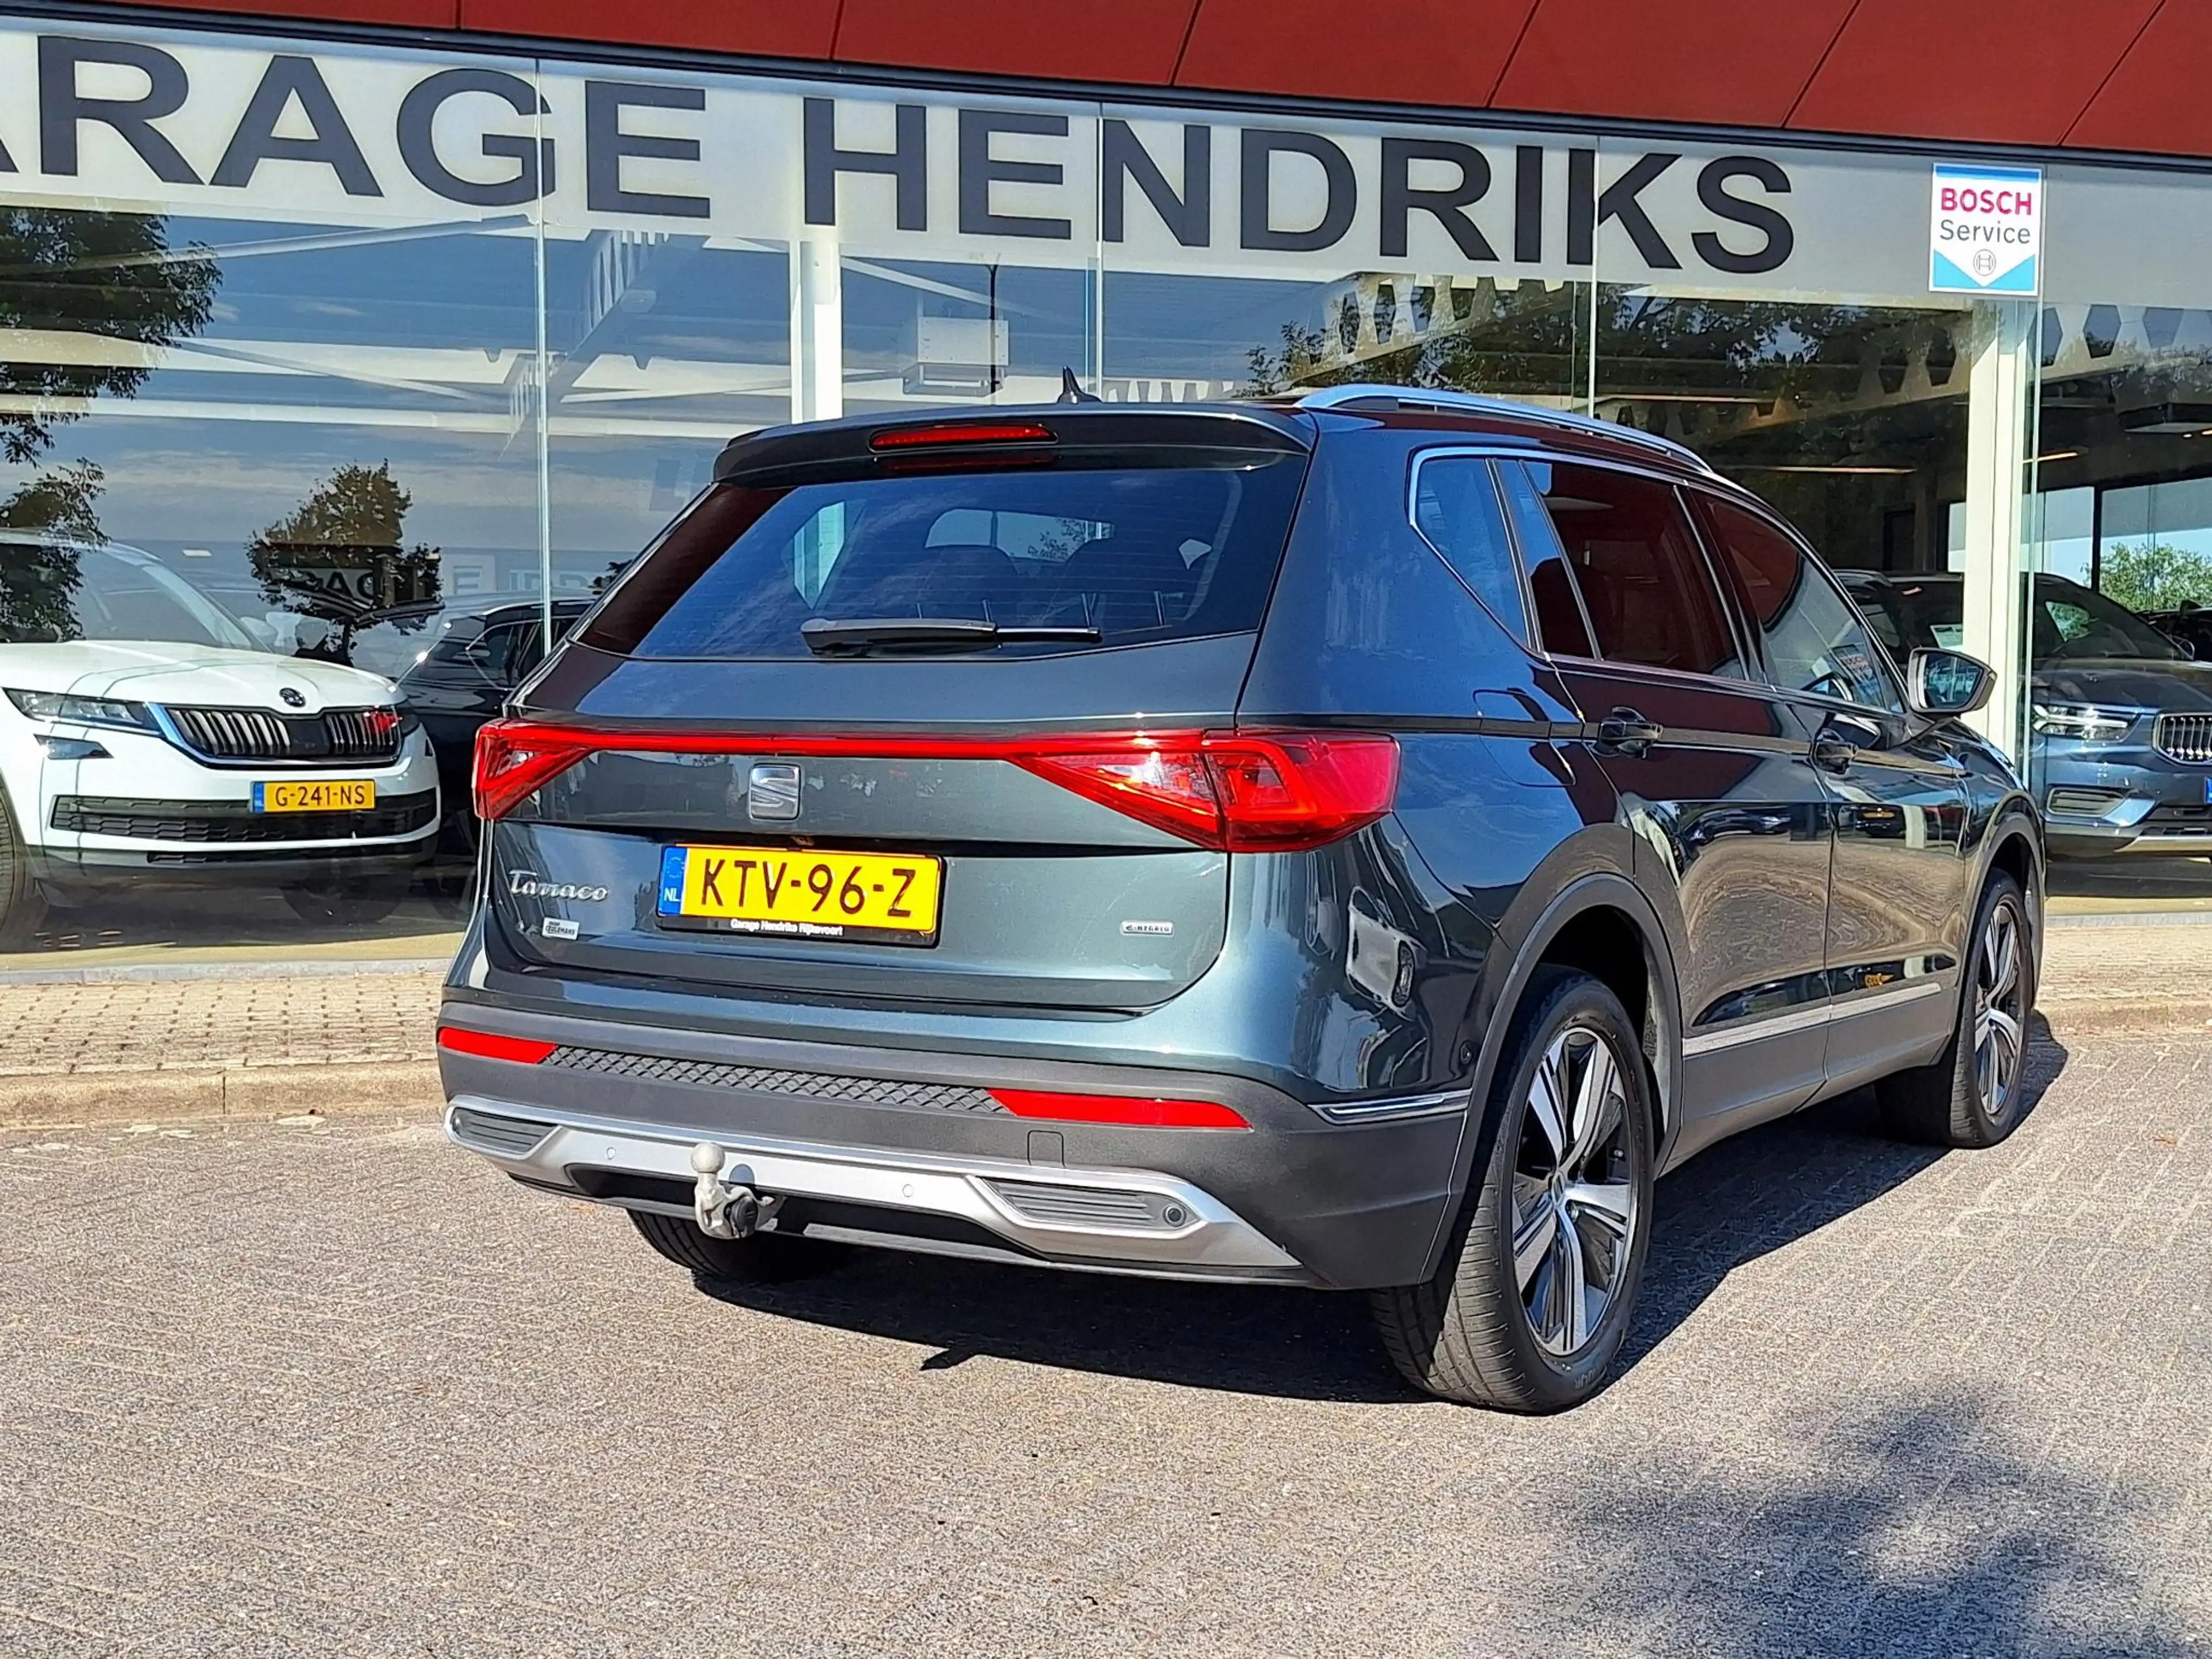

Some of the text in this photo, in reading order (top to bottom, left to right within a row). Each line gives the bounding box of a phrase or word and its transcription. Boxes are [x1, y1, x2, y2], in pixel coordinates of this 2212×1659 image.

[0, 36, 1793, 275] RAGE HENDRIKS
[1941, 187, 2032, 215] BOSCH
[1939, 219, 2031, 244] Service
[275, 785, 365, 806] G-241-NS
[509, 870, 608, 900] Tarraco
[664, 887, 681, 902] NL
[701, 858, 917, 918] KTV-96-Z
